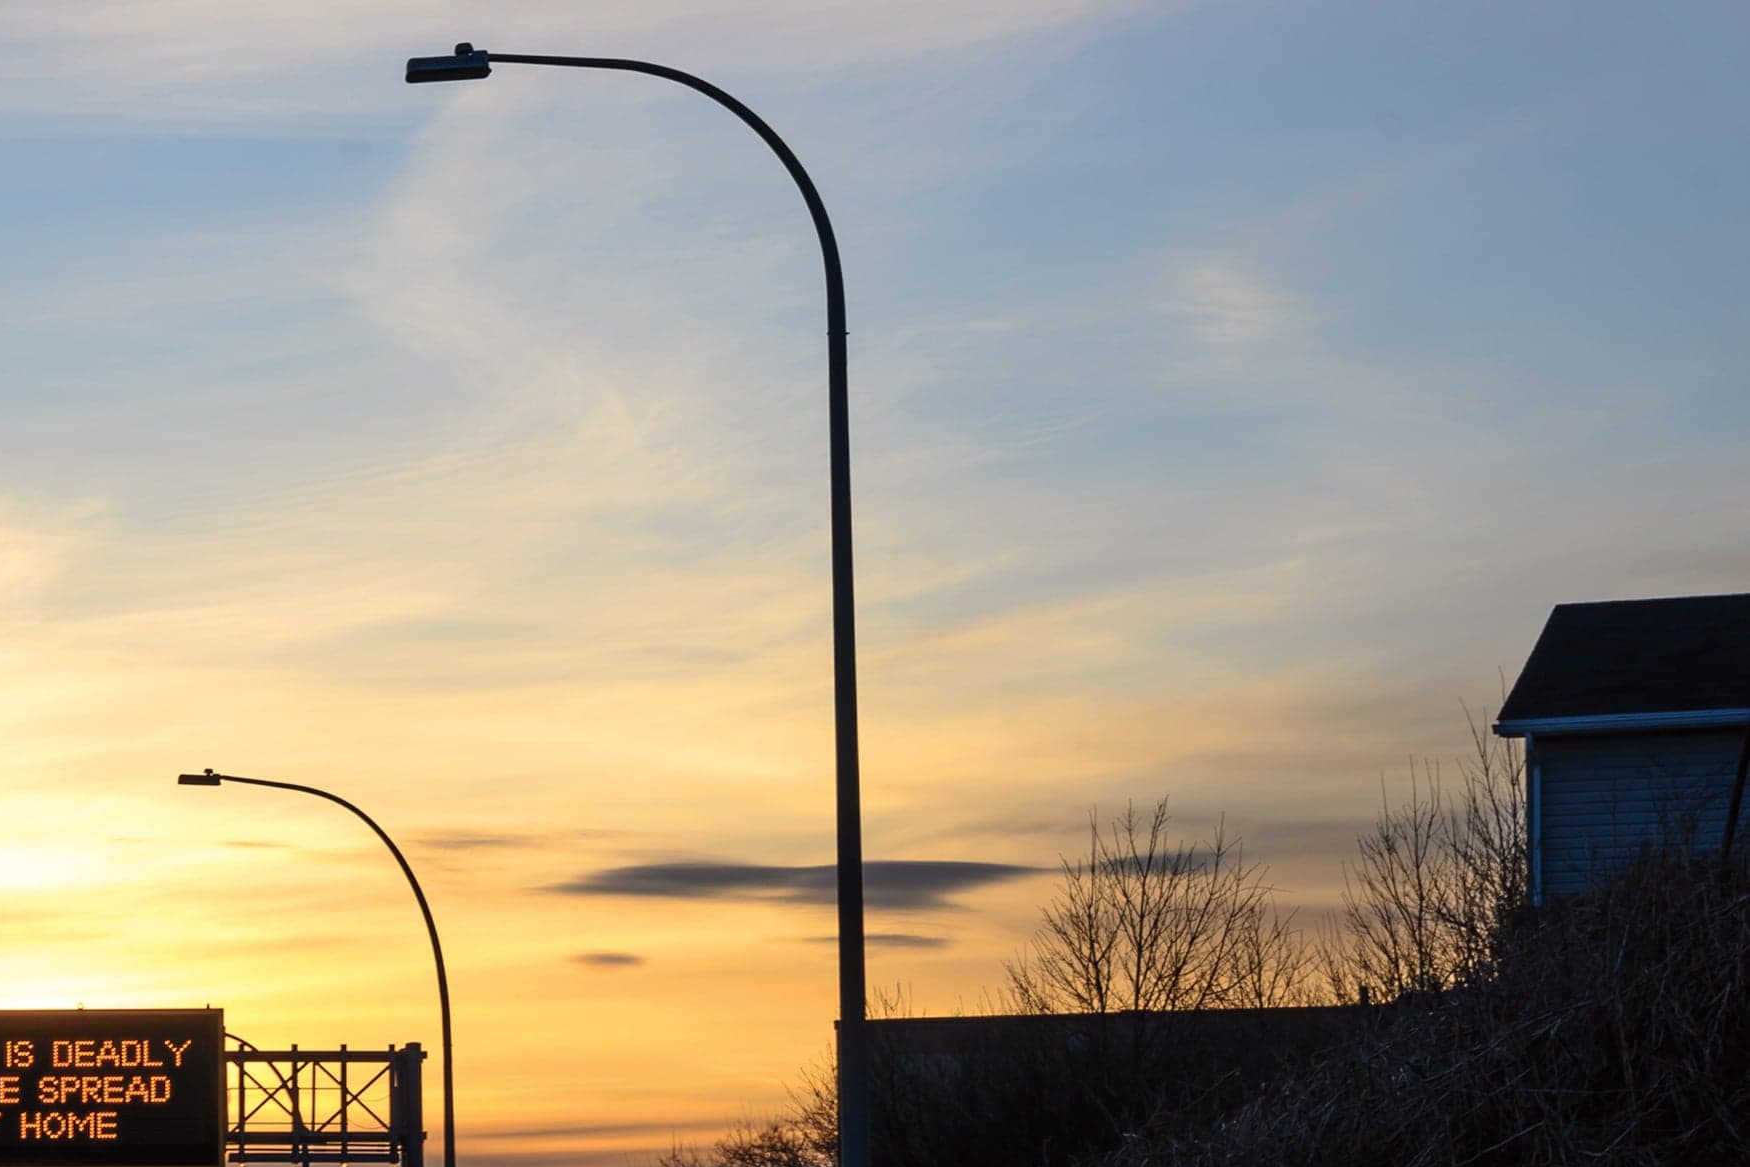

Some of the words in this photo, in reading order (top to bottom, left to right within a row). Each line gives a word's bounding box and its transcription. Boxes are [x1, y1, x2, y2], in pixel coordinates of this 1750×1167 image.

[5, 1040, 35, 1068] IS
[52, 1039, 192, 1068] DEADLY
[38, 1075, 171, 1104] SPREAD
[19, 1111, 118, 1140] HOME
